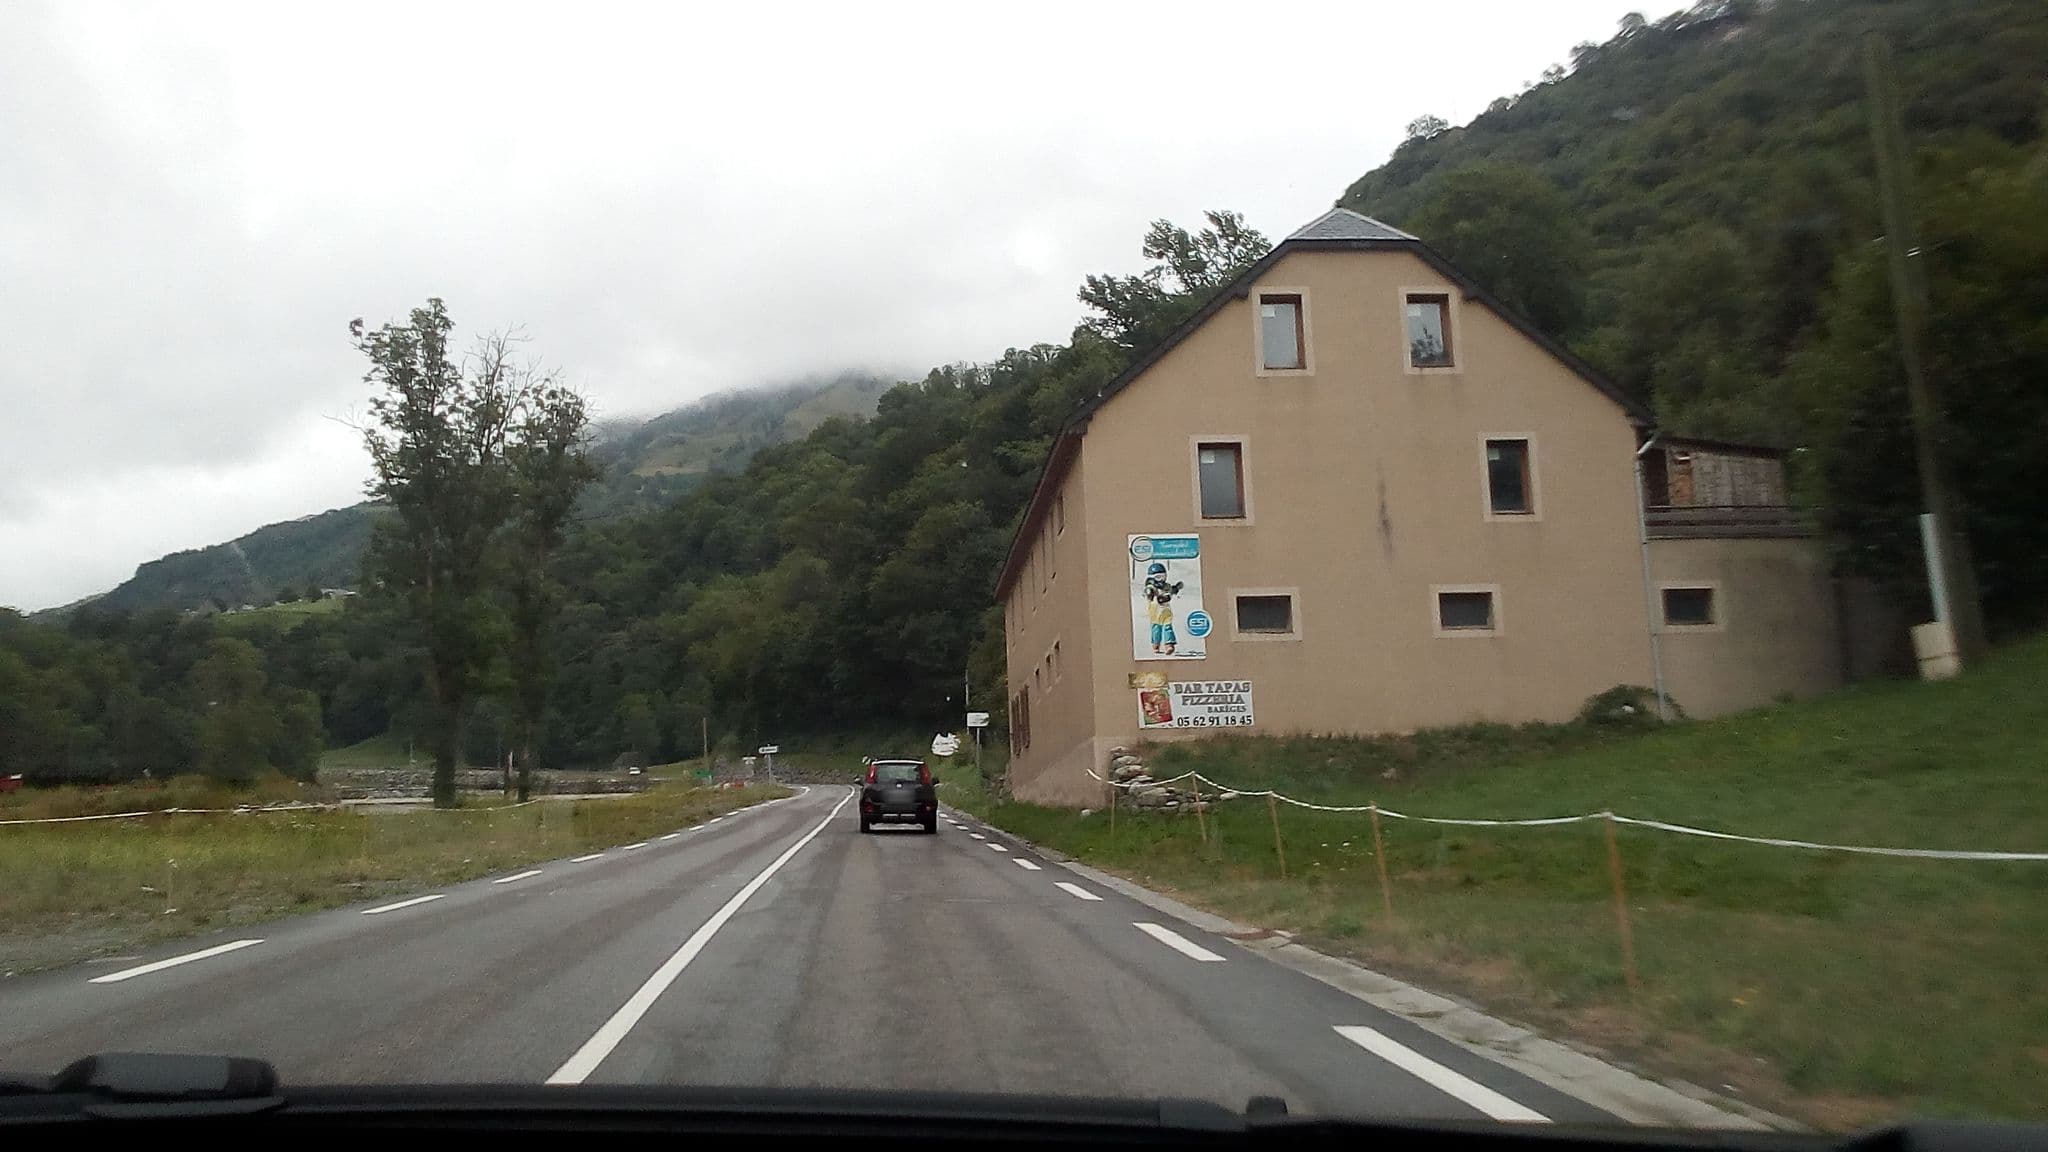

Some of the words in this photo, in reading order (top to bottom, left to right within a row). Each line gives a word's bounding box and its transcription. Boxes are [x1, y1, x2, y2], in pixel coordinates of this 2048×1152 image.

[1174, 683, 1203, 694] BAR
[1205, 682, 1251, 693] TAPAS
[1182, 695, 1245, 706] PIZZERIA
[1177, 716, 1190, 727] 05
[1193, 716, 1206, 726] 62
[1208, 716, 1220, 726] 91
[1225, 716, 1236, 725] 18
[1239, 715, 1252, 725] 45
